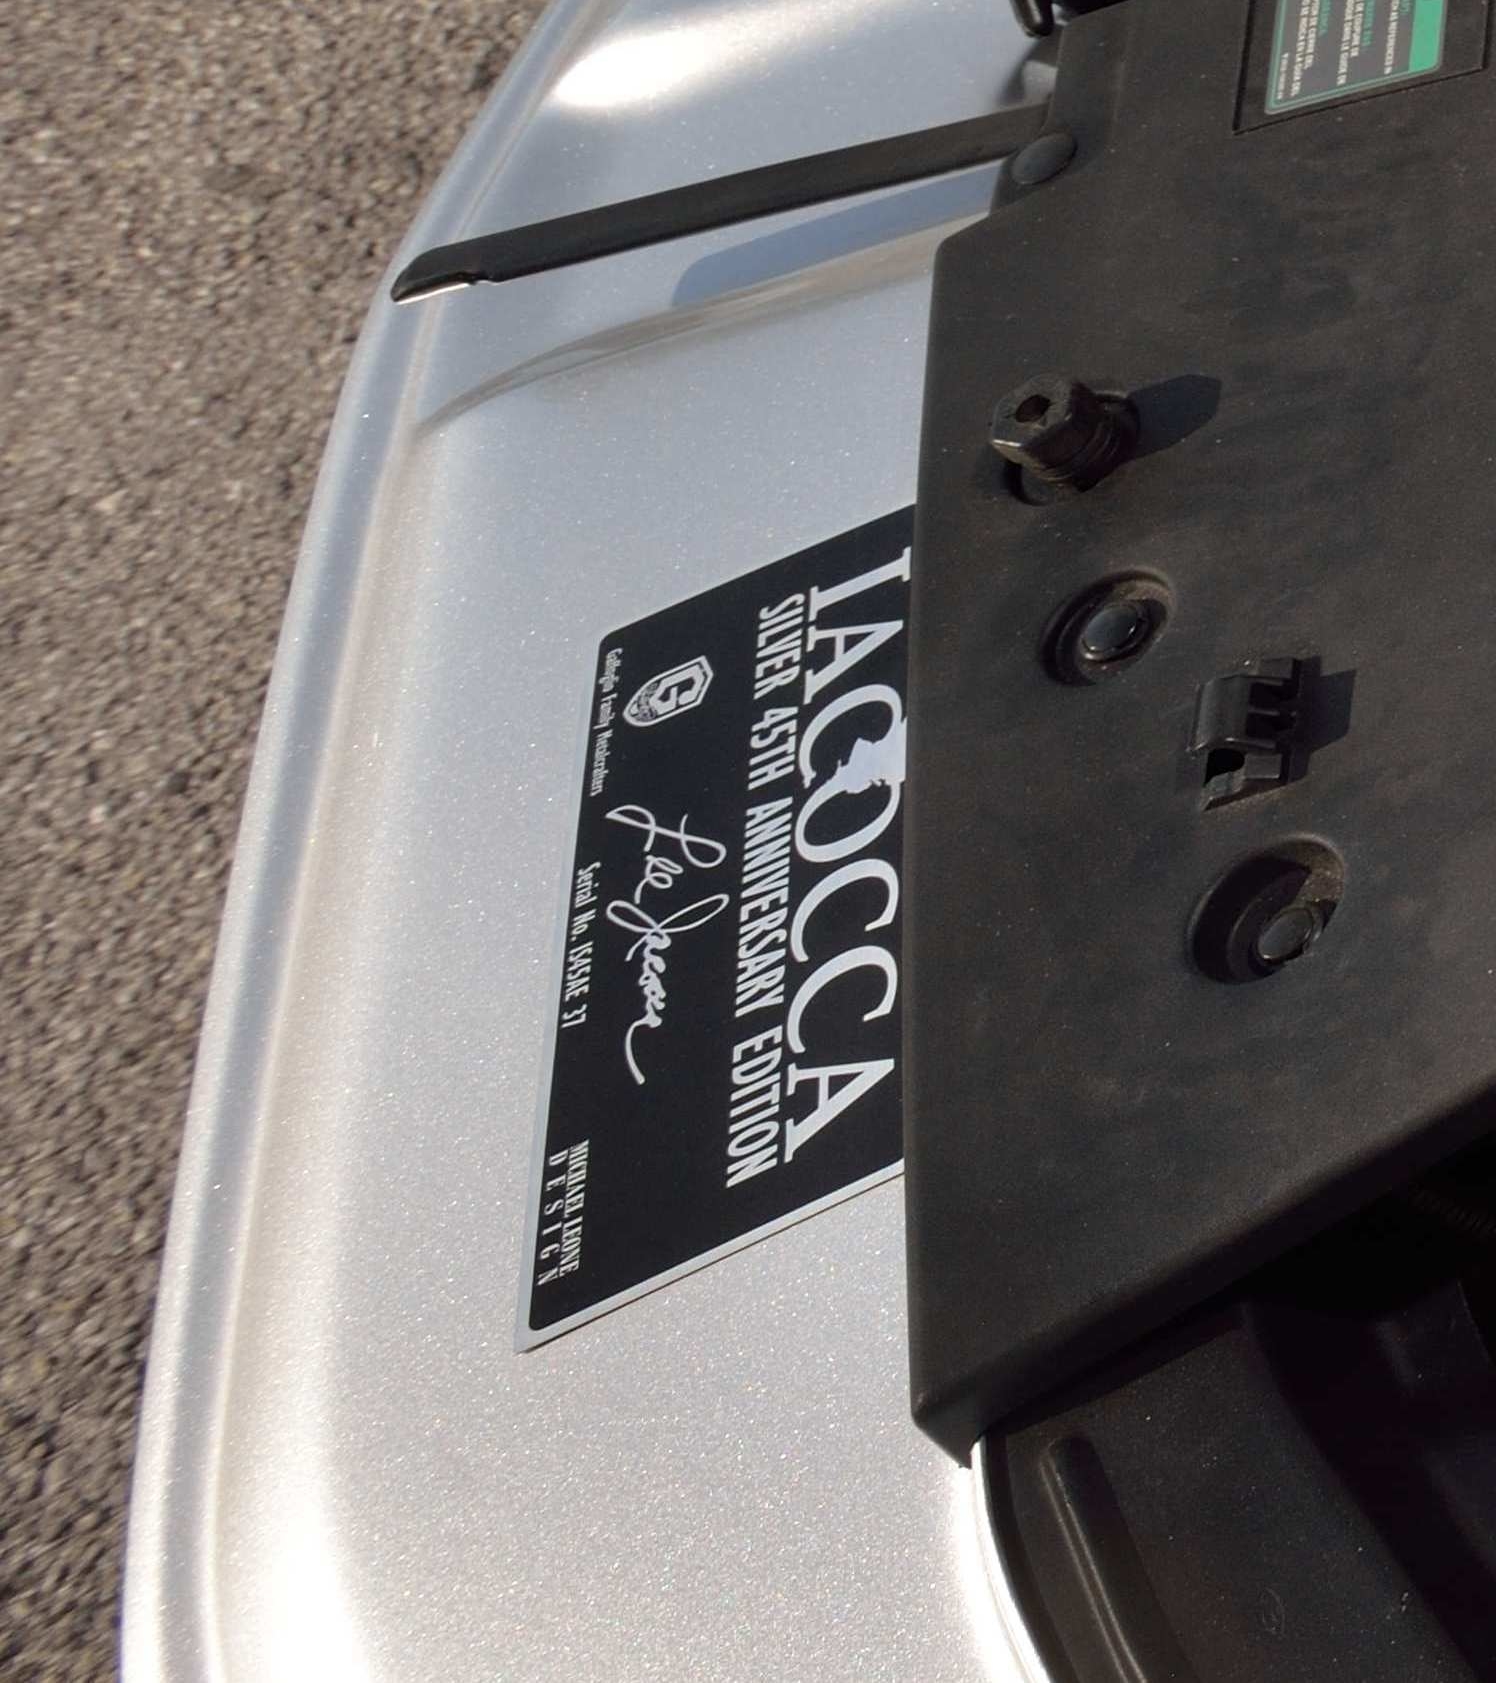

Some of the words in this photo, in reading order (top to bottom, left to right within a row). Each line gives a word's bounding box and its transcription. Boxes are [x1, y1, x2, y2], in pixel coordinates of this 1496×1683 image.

[755, 592, 804, 699] SILVER
[592, 693, 618, 729] Family
[748, 705, 797, 790] 45TH
[589, 729, 613, 798] Metalcrafters
[574, 861, 602, 908] Serial
[785, 546, 911, 1163] IACOCCA
[570, 908, 597, 941] No.
[734, 795, 792, 1018] ANNIVERSARY
[560, 1004, 588, 1030] 37
[726, 1025, 783, 1188] EDITION
[563, 1139, 590, 1219] MICHAEL
[559, 1216, 583, 1278] LEONE
